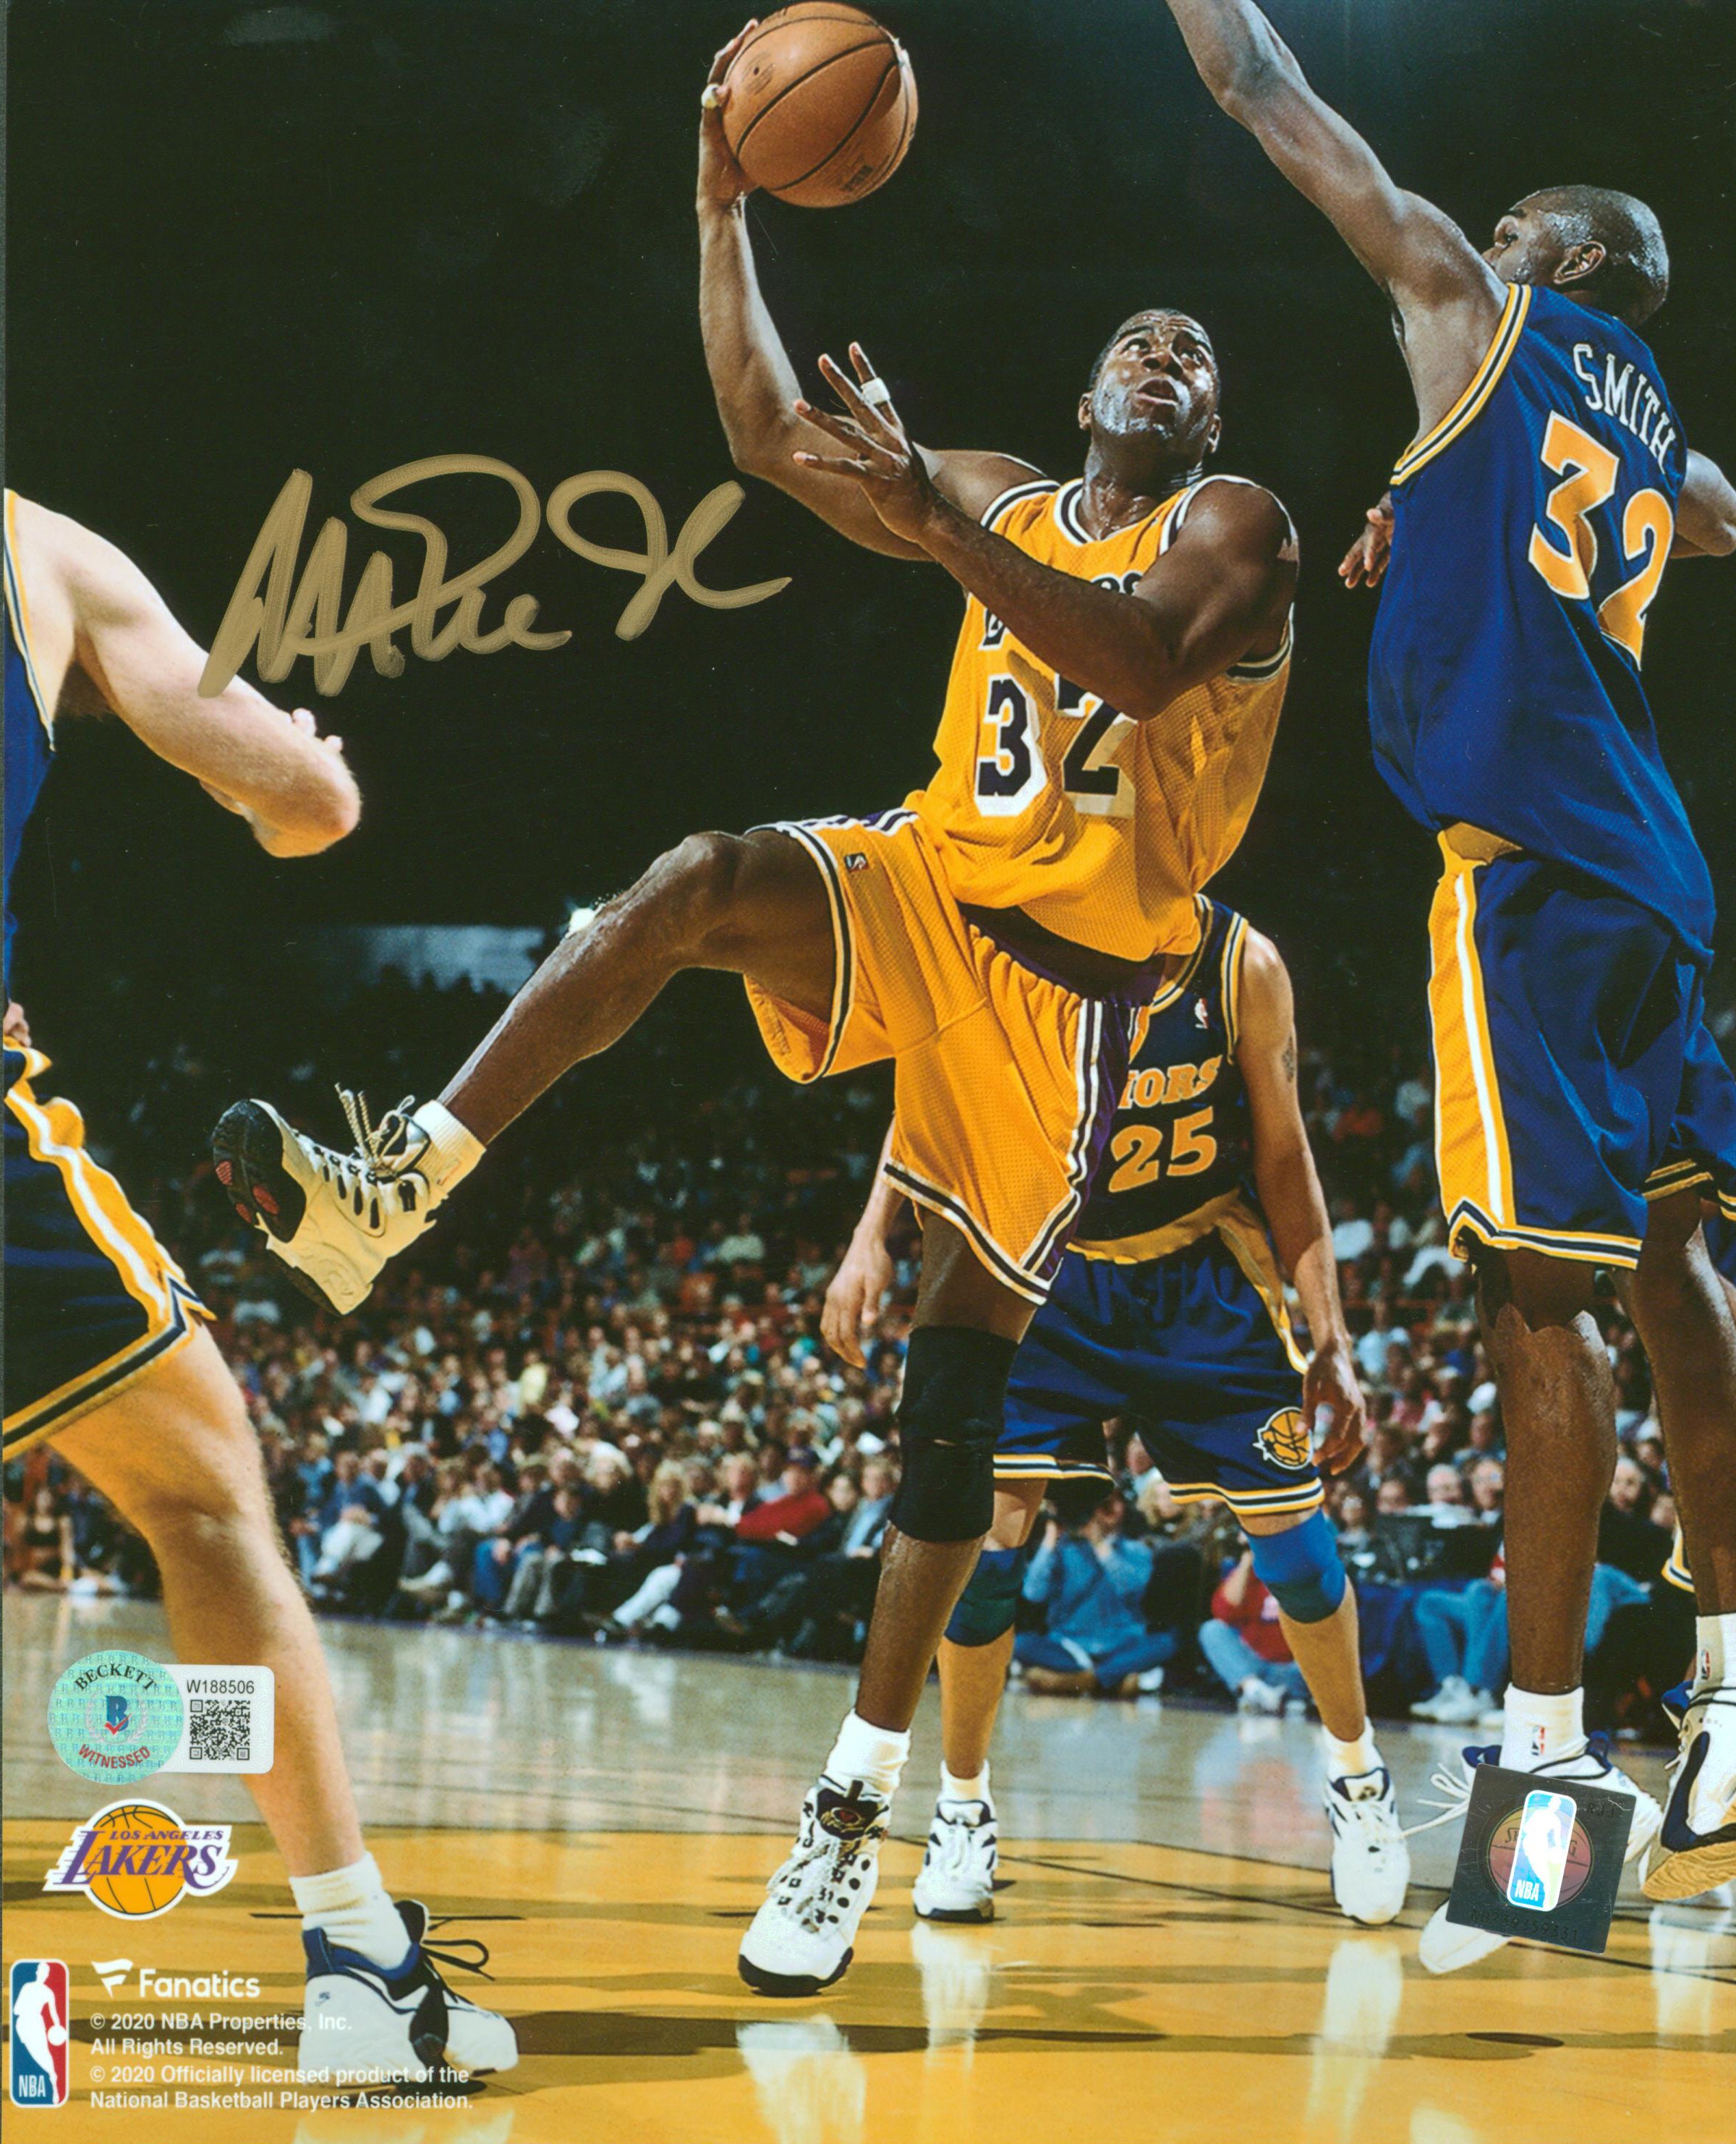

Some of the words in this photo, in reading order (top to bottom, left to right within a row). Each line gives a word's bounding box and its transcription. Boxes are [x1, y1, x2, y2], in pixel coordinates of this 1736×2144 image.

[1573, 343, 1676, 475] SMITH
[1528, 409, 1675, 672] 32
[974, 672, 1136, 818] 32
[1118, 1055, 1222, 1110] IORS
[1108, 1106, 1217, 1193] 25
[74, 1663, 157, 1691] BECKETT
[187, 1679, 255, 1695] W188506
[78, 1744, 151, 1769] WITNESSED
[1514, 1879, 1540, 1902] NBA
